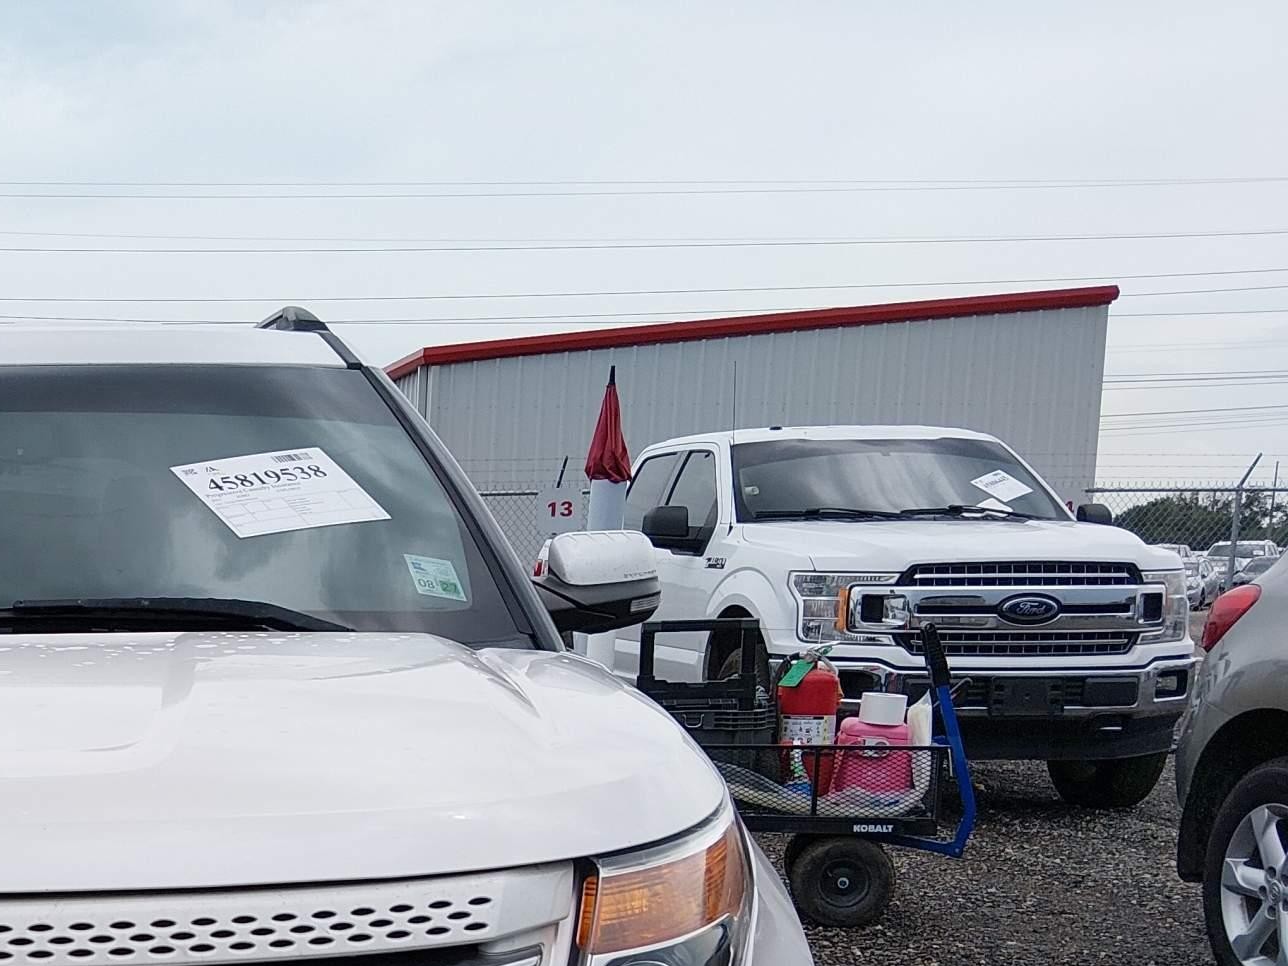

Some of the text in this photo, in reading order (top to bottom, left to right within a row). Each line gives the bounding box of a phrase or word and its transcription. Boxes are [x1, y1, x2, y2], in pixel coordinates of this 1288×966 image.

[208, 464, 327, 491] 45819538
[548, 501, 573, 517] 13
[1016, 602, 1046, 615] Ford
[853, 824, 894, 833] KOBALT
